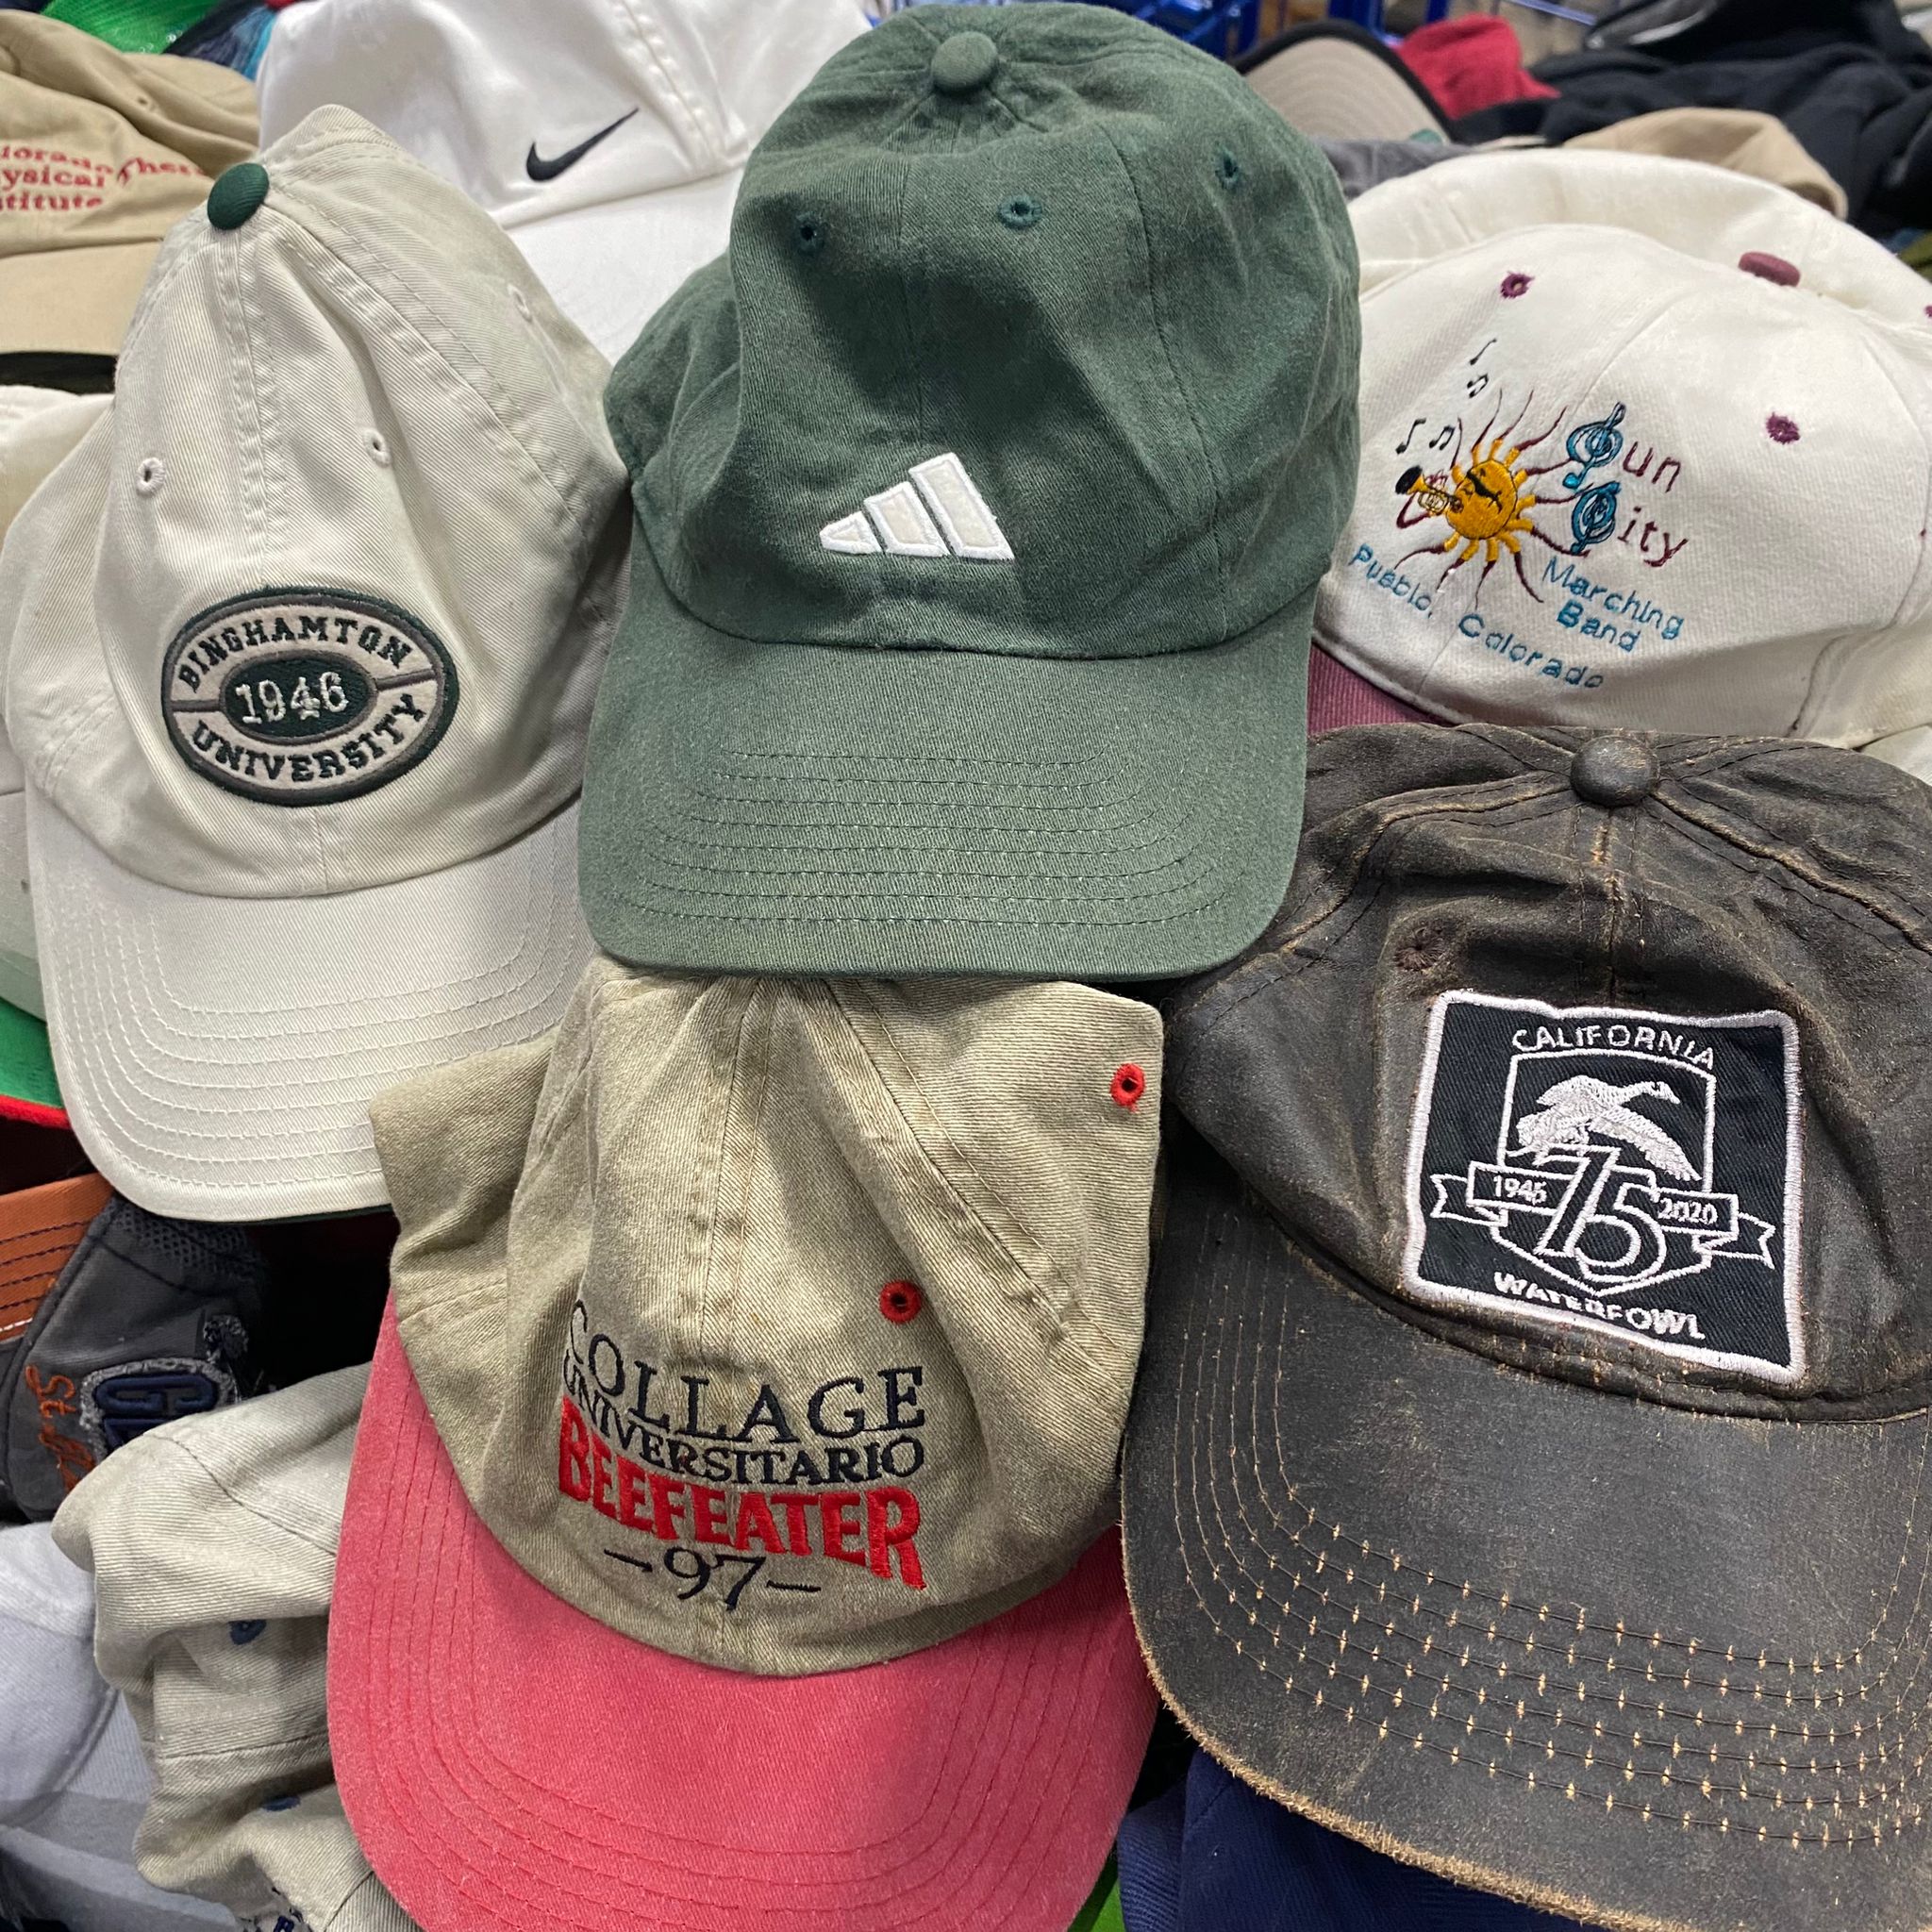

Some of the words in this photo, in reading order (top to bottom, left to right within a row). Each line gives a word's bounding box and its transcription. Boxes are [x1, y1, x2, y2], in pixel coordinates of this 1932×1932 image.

[1541, 557, 1685, 641] Marching
[1557, 601, 1641, 653] Band
[178, 615, 413, 693] BINGHAMTON
[1457, 613, 1605, 689] Colorado
[192, 693, 426, 782] UNIVERSITY
[236, 671, 349, 724] 1946
[1511, 1024, 1715, 1071] CALIFORNIA
[1507, 1142, 1668, 1284] 75
[1657, 1197, 1719, 1225] 2020
[1492, 1271, 1707, 1340] WATERFOWL
[569, 1299, 926, 1444] COLLAGE
[563, 1349, 925, 1486] UNIVERSITARIO
[558, 1395, 927, 1591] BEEFEATER
